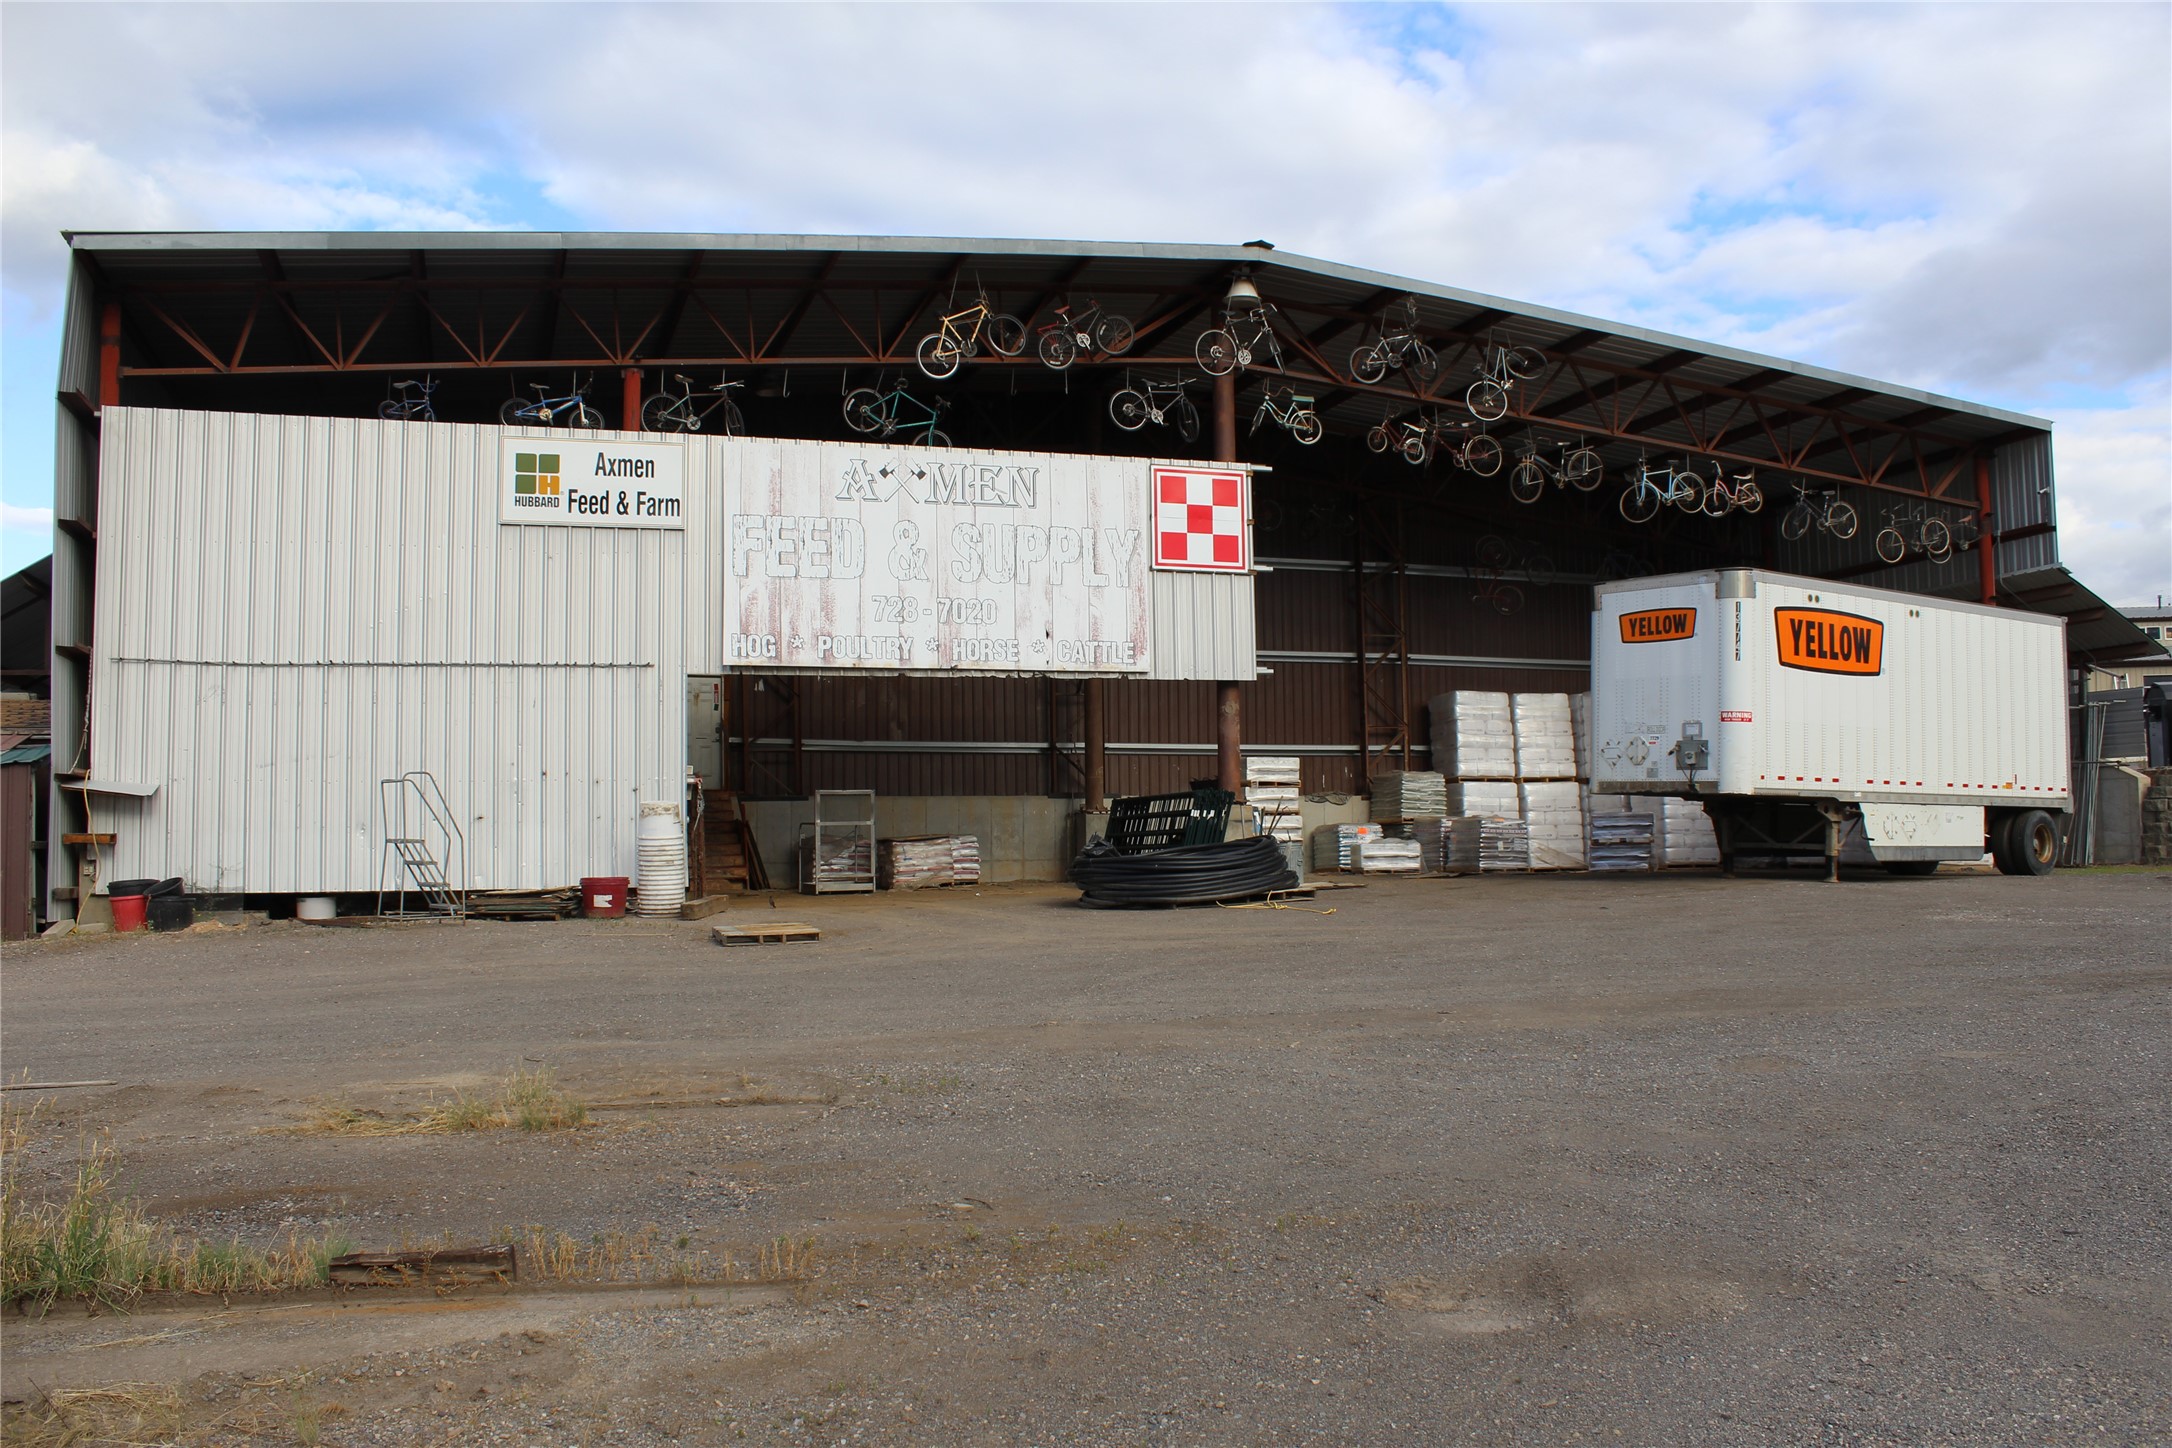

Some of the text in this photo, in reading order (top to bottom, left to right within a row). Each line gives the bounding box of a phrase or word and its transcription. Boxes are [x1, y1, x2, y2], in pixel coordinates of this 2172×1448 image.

[594, 451, 655, 478] Axmen
[514, 495, 560, 508] HUBBARD
[568, 488, 681, 518] Feed & Farm
[731, 514, 1140, 588] FEED & SUPPLY
[1628, 613, 1688, 637] YELLOW
[731, 633, 1137, 666] HOG POULTRY HORSE CATTLE
[1789, 618, 1872, 664] YELLOW
[1721, 711, 1752, 719] WARNING
